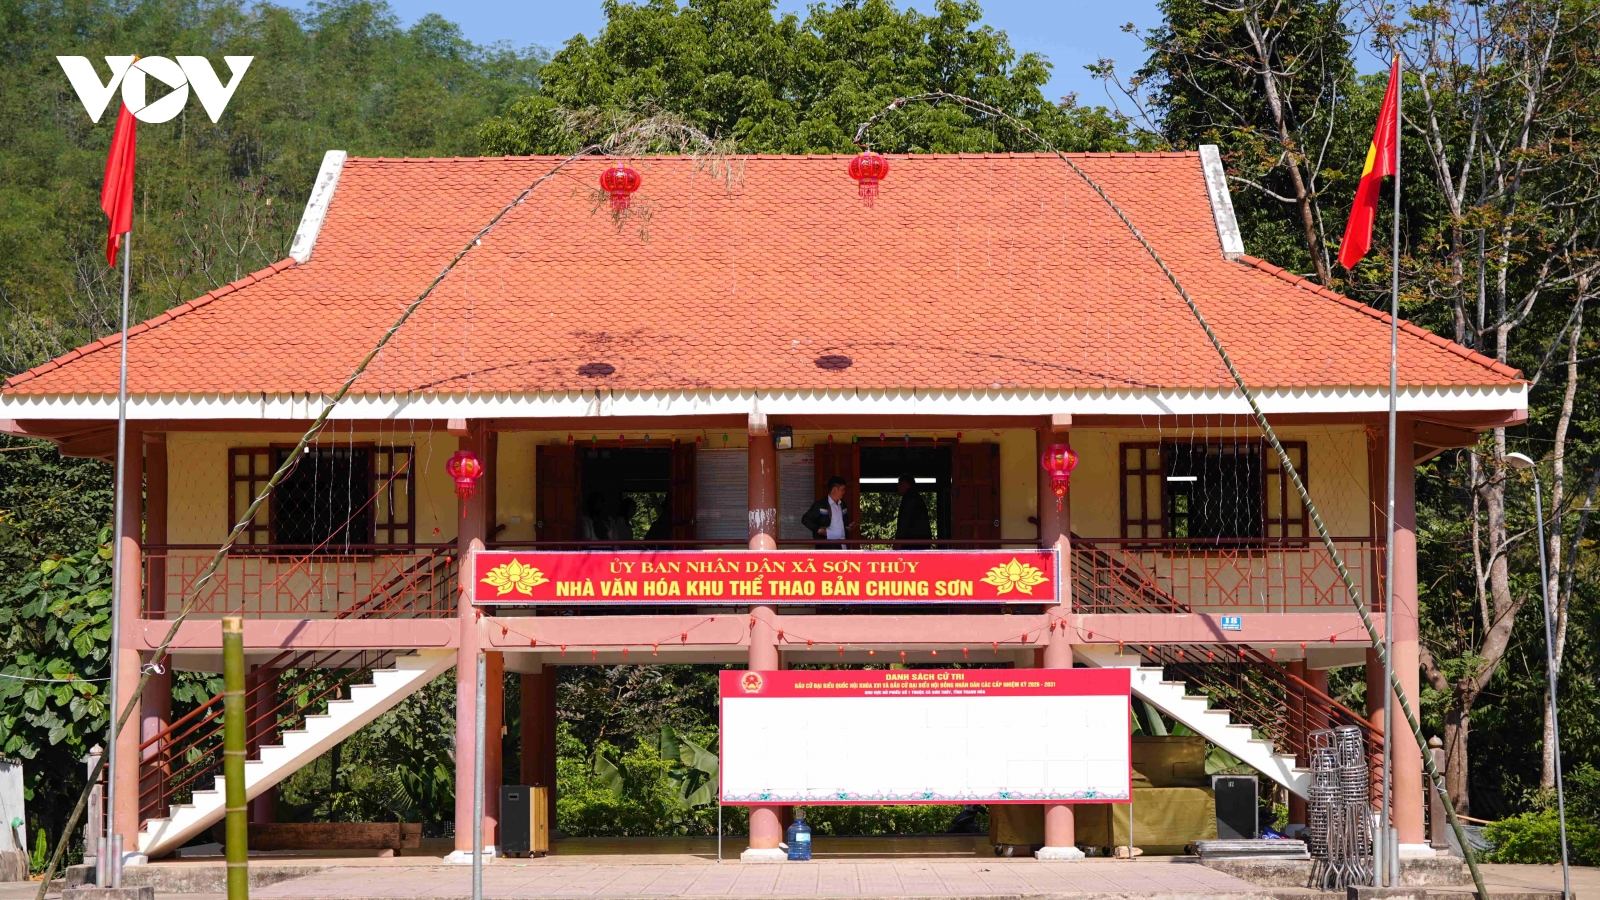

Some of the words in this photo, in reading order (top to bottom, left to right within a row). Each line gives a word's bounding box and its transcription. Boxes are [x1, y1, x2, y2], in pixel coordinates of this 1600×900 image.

[610, 558, 635, 574] ỦY
[641, 561, 681, 573] BAN
[686, 558, 740, 573] NHÂN
[745, 557, 786, 573] DÂN
[791, 558, 818, 573] XÃ
[822, 559, 862, 573] SƠN
[867, 557, 919, 573] THỦY
[556, 578, 595, 596] NHÀ
[600, 578, 638, 596] VĂN
[643, 578, 681, 596] HÓA
[686, 581, 724, 596] KHU
[729, 574, 764, 596] THỂ
[768, 580, 816, 596] THAO
[821, 575, 860, 596] BẢN
[865, 580, 929, 596] CHUNG
[935, 579, 973, 596] SƠN
[912, 672, 934, 680] SÁCH
[937, 671, 950, 680] CỬ
